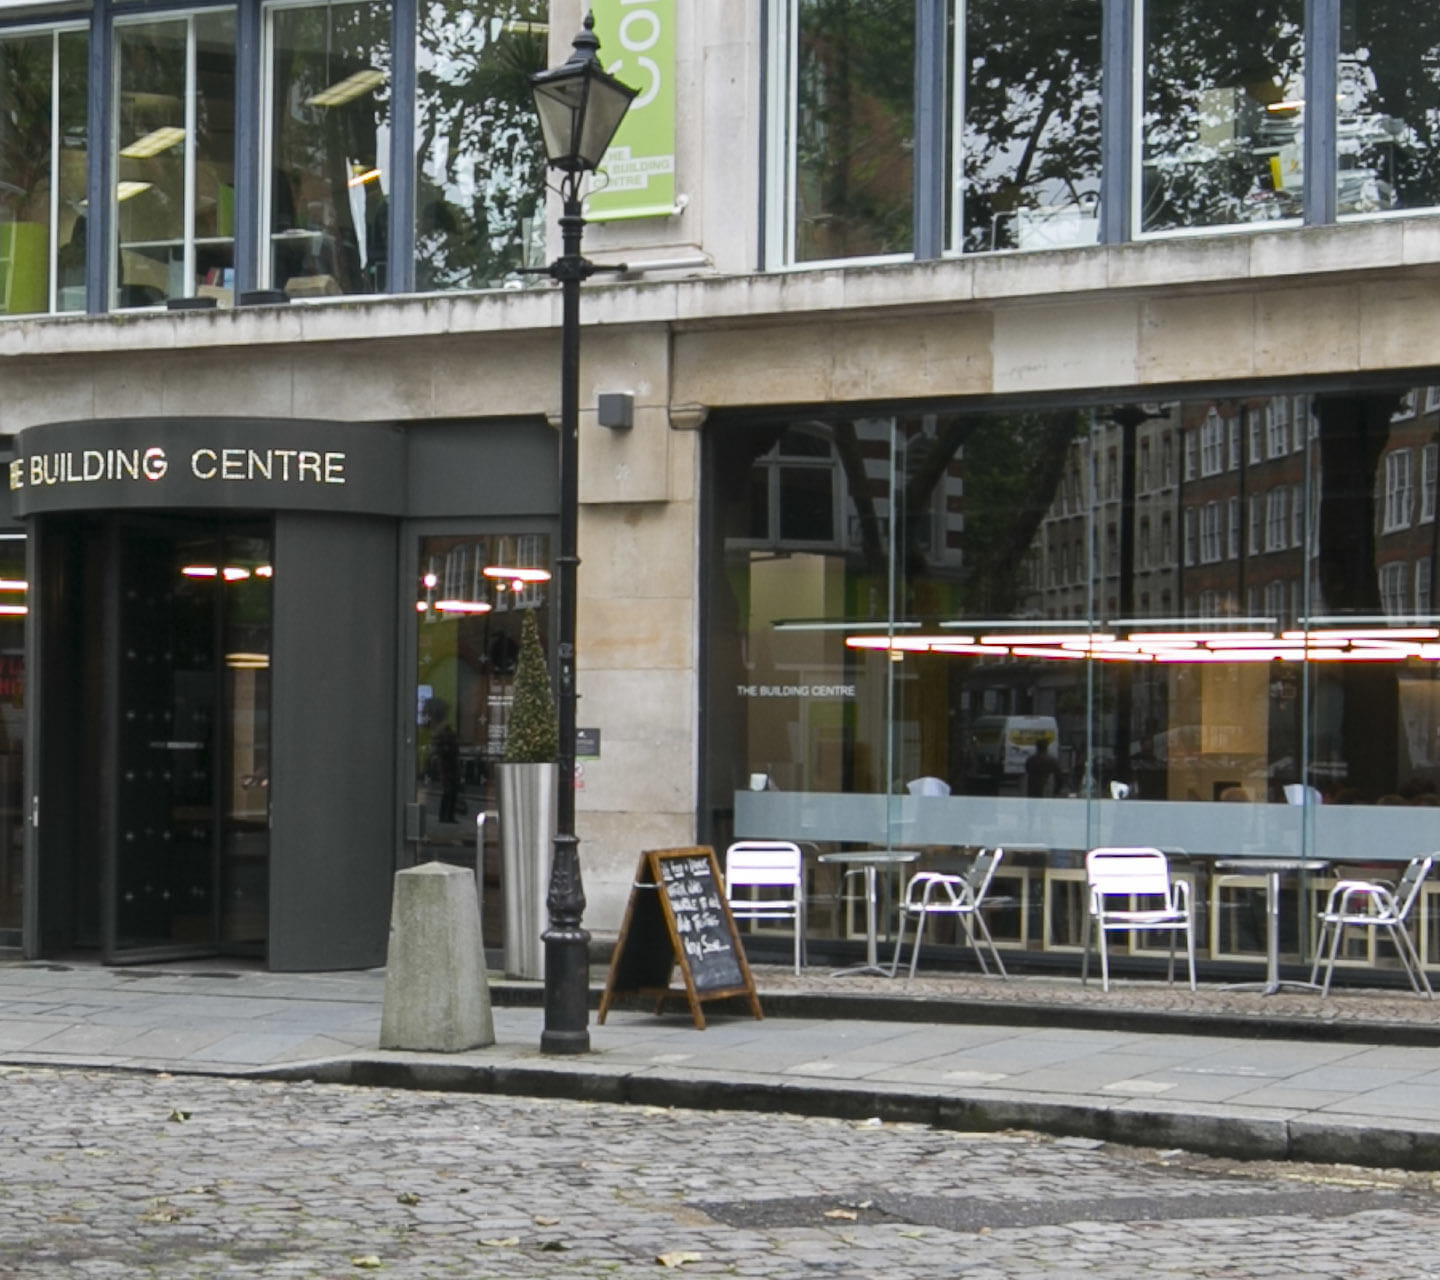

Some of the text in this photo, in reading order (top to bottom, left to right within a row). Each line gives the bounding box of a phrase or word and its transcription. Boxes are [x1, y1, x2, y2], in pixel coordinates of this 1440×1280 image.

[613, 160, 670, 174] BUILDING
[30, 447, 168, 485] BUILDING
[191, 448, 346, 484] CENTRE
[737, 684, 856, 697] THE BUILDING CENTRE
